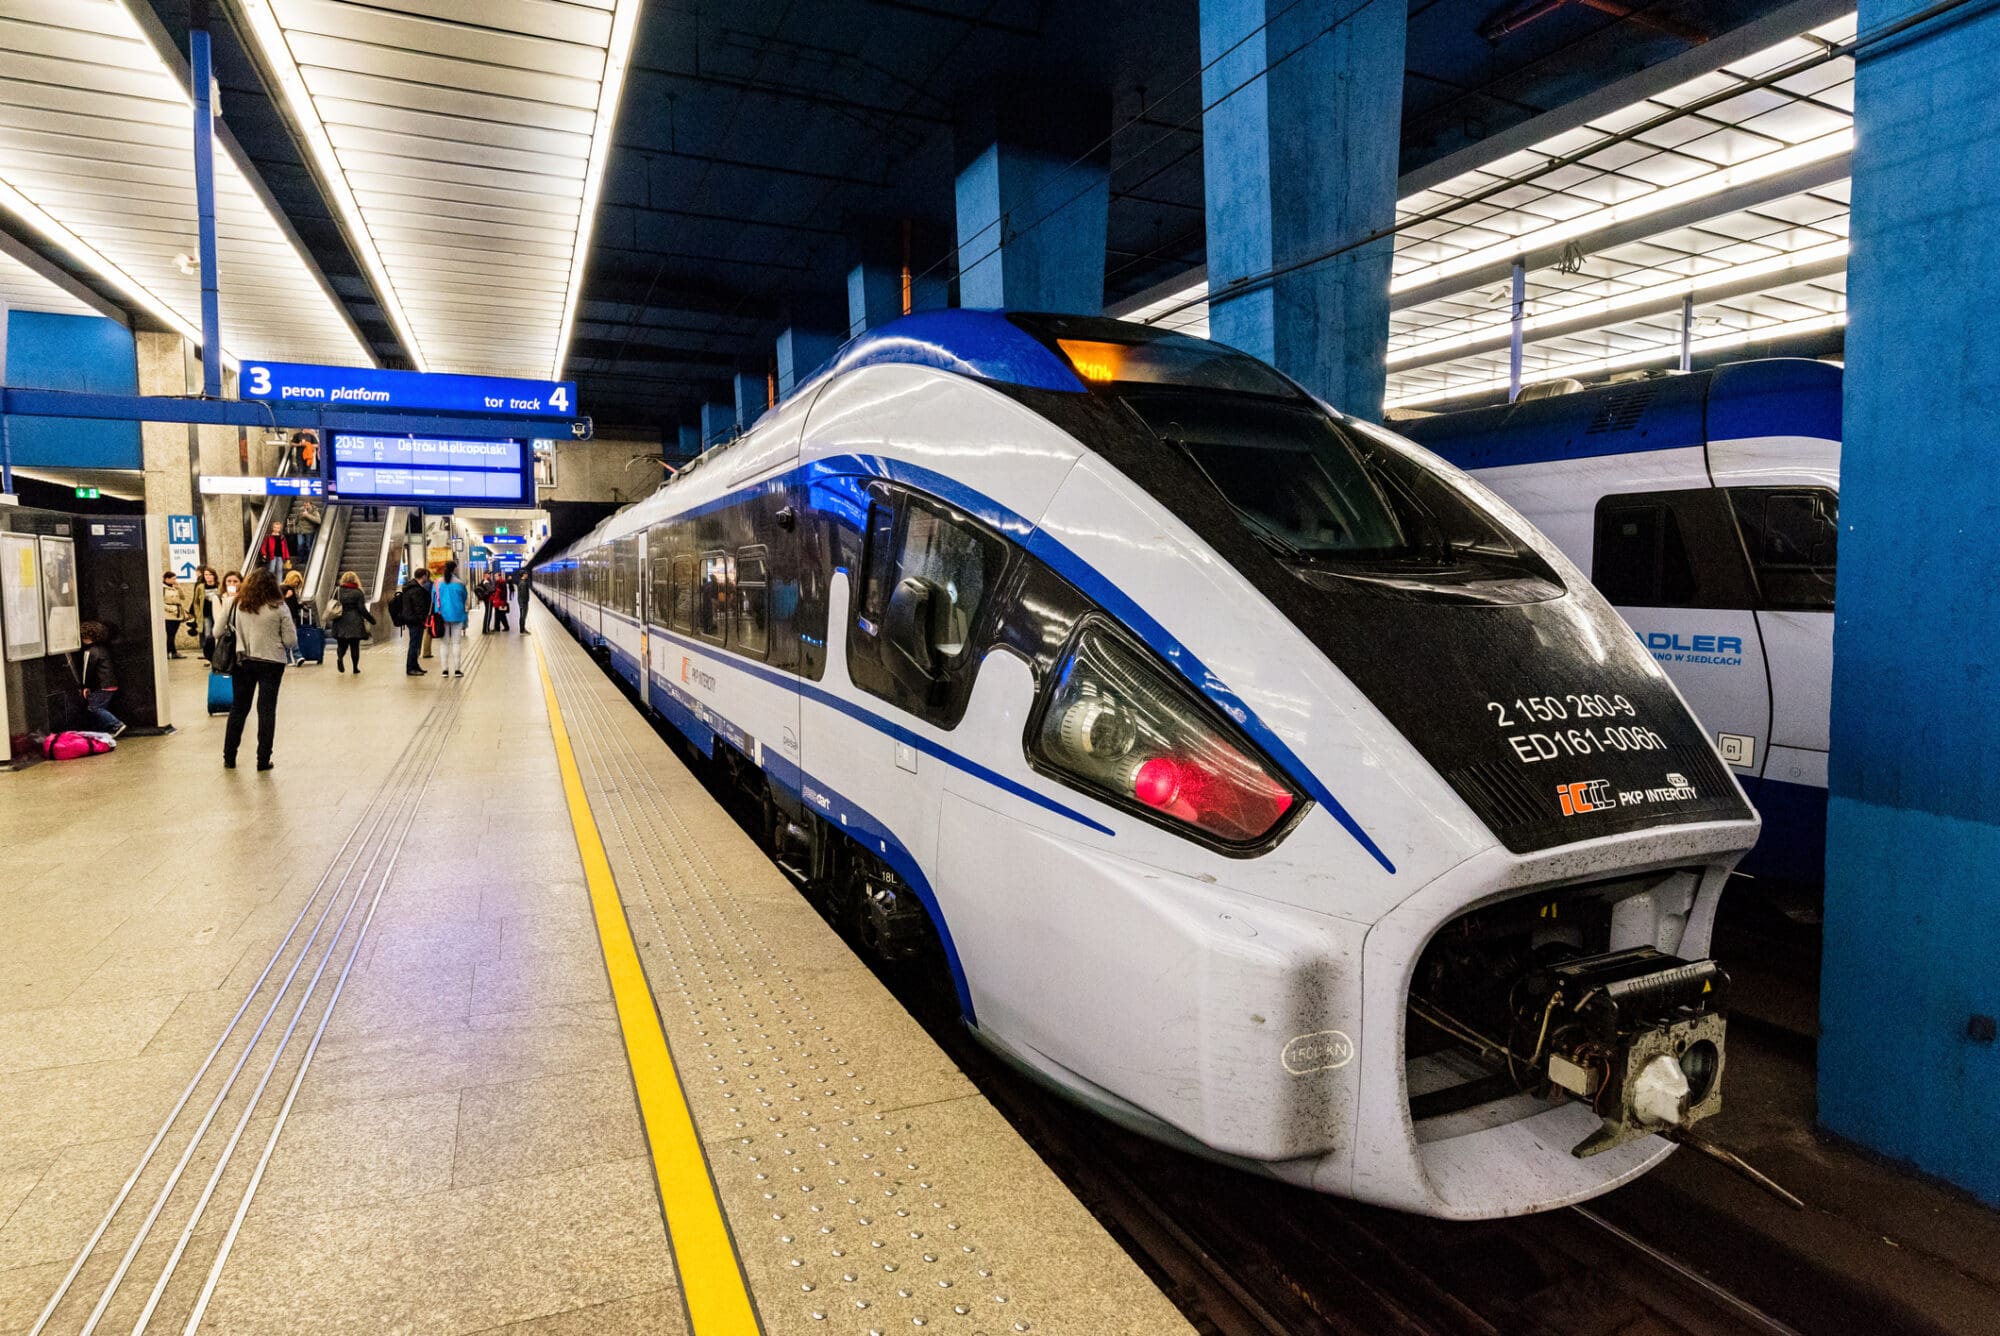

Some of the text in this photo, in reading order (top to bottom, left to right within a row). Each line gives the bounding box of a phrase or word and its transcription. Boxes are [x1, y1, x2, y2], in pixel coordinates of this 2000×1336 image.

[250, 366, 390, 401] 3 peron platform
[484, 387, 569, 412] tor track 4
[1675, 653, 1685, 662] W
[1686, 654, 1742, 666] SIEDLCACH
[1487, 694, 1636, 727] 2 150 260-9
[1508, 726, 1668, 763] ED161-006h
[1619, 790, 1644, 806] PKP
[1645, 786, 1698, 803] INTERCITY
